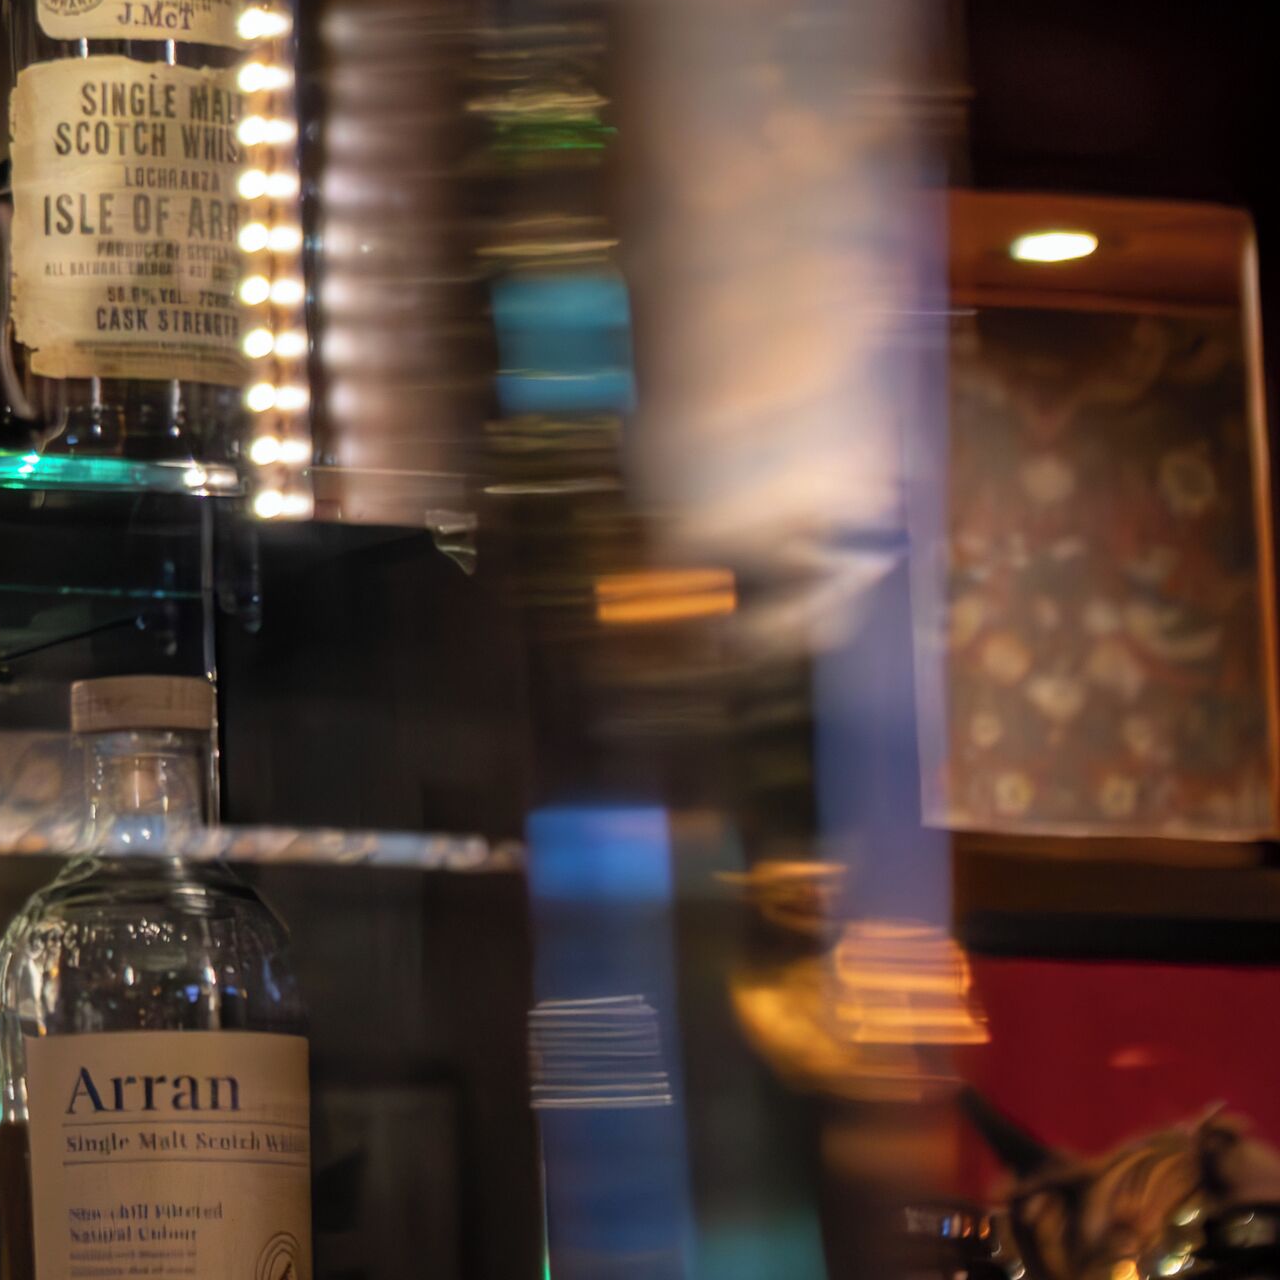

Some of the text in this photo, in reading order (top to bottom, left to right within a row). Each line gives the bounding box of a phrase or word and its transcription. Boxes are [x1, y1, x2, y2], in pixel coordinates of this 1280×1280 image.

[117, 1, 194, 31] J.McT
[81, 81, 177, 120] SINGLE
[54, 121, 167, 158] SCOTCH
[124, 165, 221, 193] LOCHRANZA
[43, 193, 115, 237] ISLE
[133, 192, 170, 236] OF
[96, 306, 149, 332] CASK
[64, 1066, 241, 1115] Arran
[66, 1132, 130, 1156] Single
[138, 1130, 189, 1153] Malt
[195, 1130, 262, 1152] Scotch
